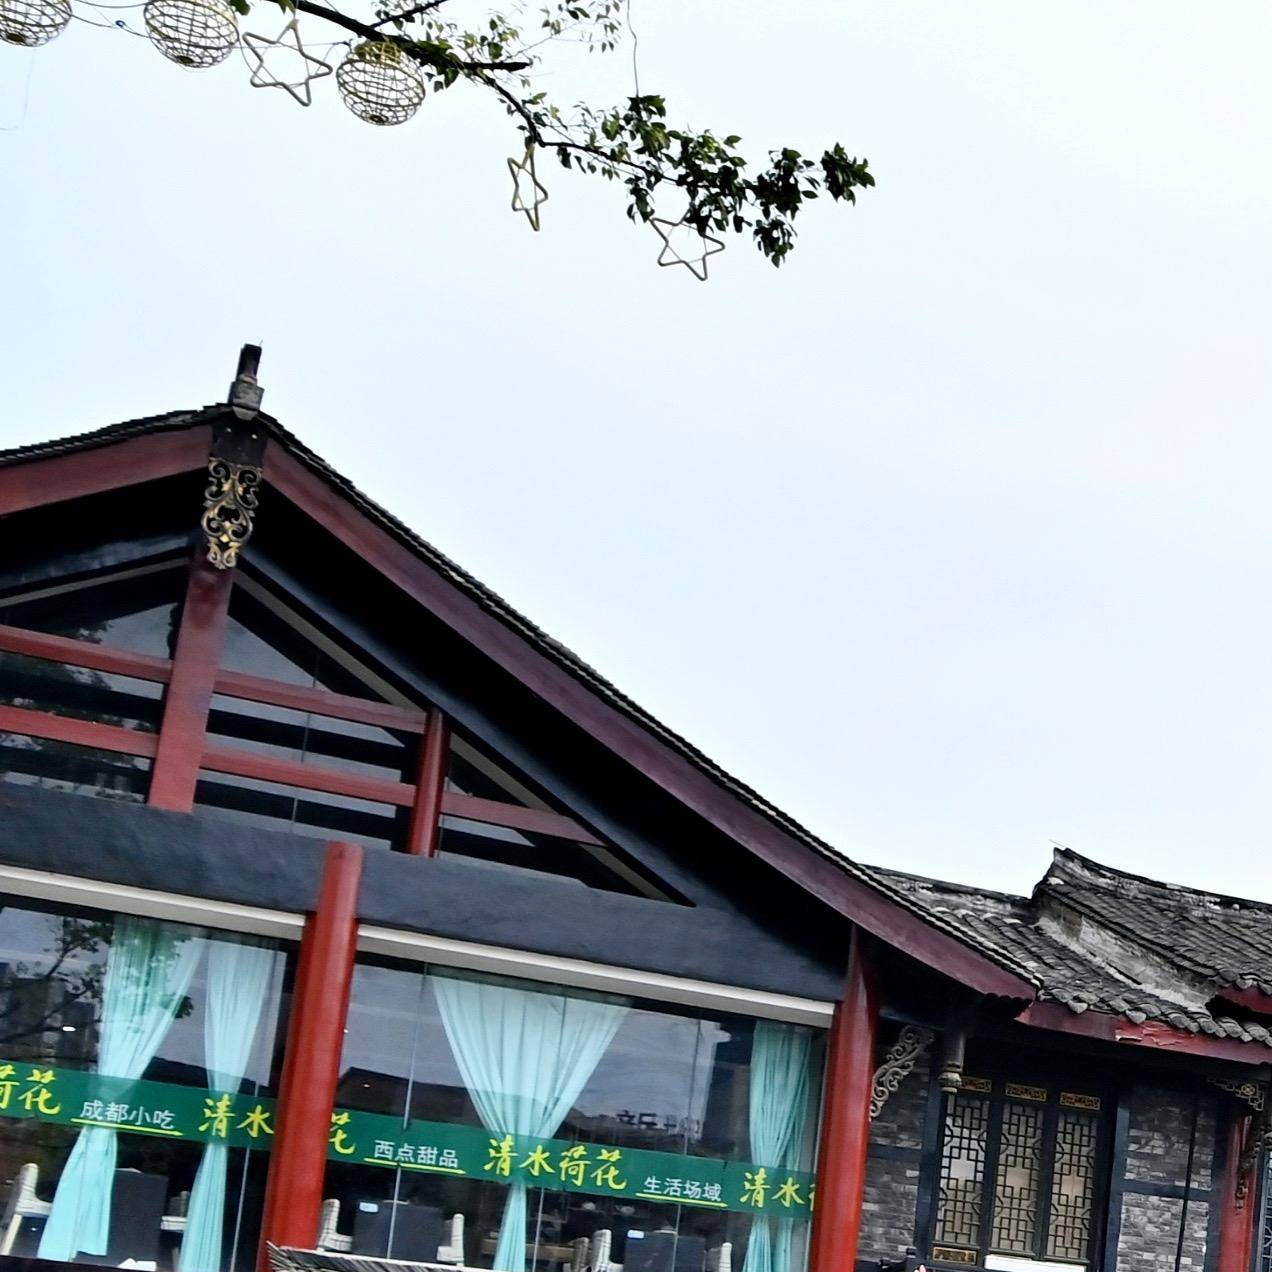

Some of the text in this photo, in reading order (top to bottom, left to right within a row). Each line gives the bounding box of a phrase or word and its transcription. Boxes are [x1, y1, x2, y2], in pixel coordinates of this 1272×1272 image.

[80, 1100, 176, 1130] 成都小吃
[374, 1139, 459, 1168] 西点甜品
[483, 1134, 628, 1190] 清水荷花
[643, 1175, 722, 1202] 生活场域
[739, 1167, 816, 1212] 清水
